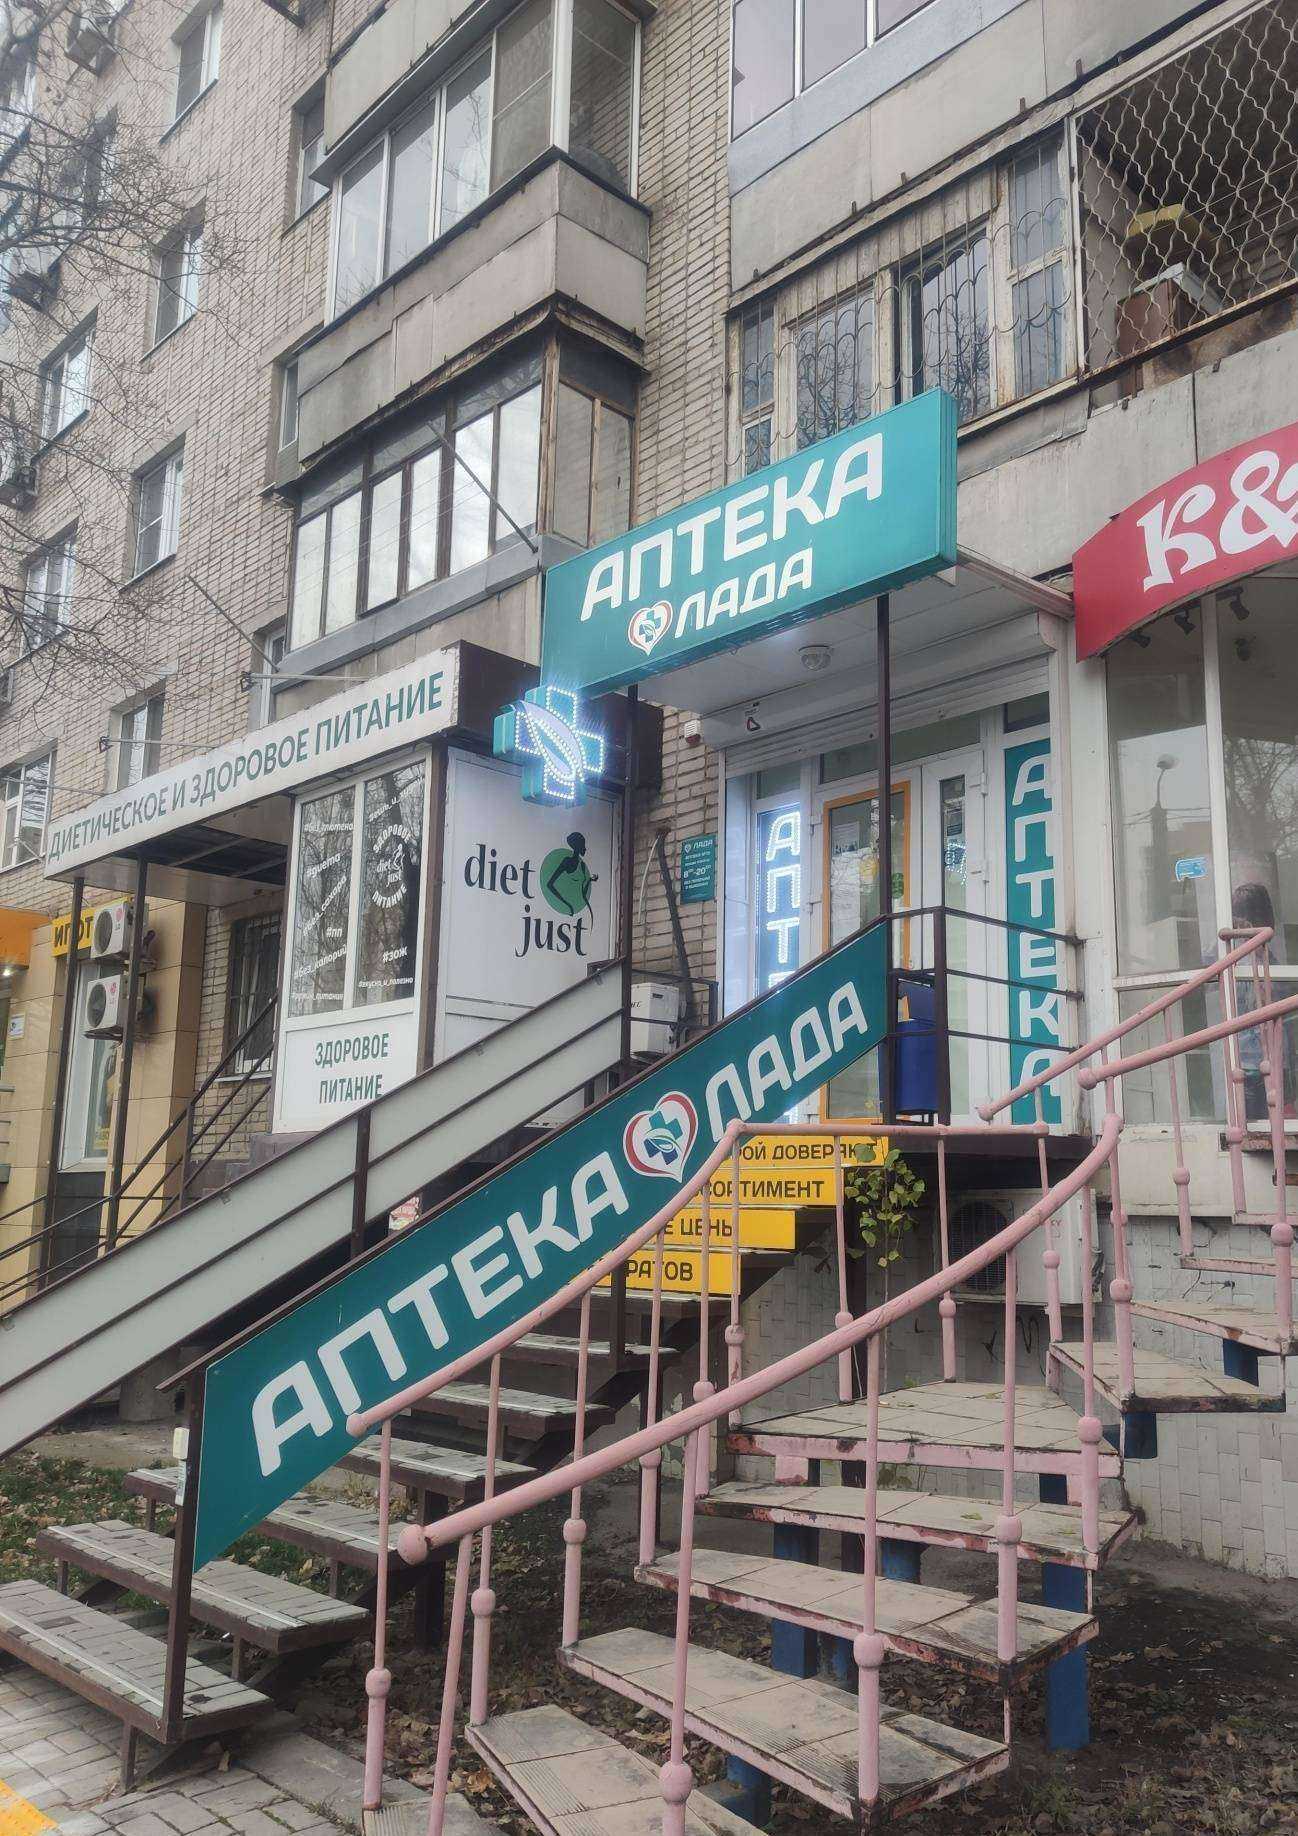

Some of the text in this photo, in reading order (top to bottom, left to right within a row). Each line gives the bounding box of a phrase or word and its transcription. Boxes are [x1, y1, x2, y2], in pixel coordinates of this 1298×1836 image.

[581, 433, 883, 622] АПТЕКА
[674, 547, 813, 638] ЛАДА
[48, 671, 444, 861] ДИЕТИЧЕСКОЕ И ЗДОРОВОЕ ПИТАНИЕ
[371, 883, 408, 909] ПИТАНИЕ
[464, 843, 536, 899] diet
[514, 903, 589, 958] just
[765, 810, 801, 993] АПТ
[1011, 754, 1061, 1099] АПТЕКА
[315, 1032, 390, 1068] ЗДОРОВОЕ
[319, 1074, 383, 1104] ПИТАНИЕ
[705, 981, 868, 1142] ЛАДА
[251, 1152, 629, 1478] АПТЕКА
